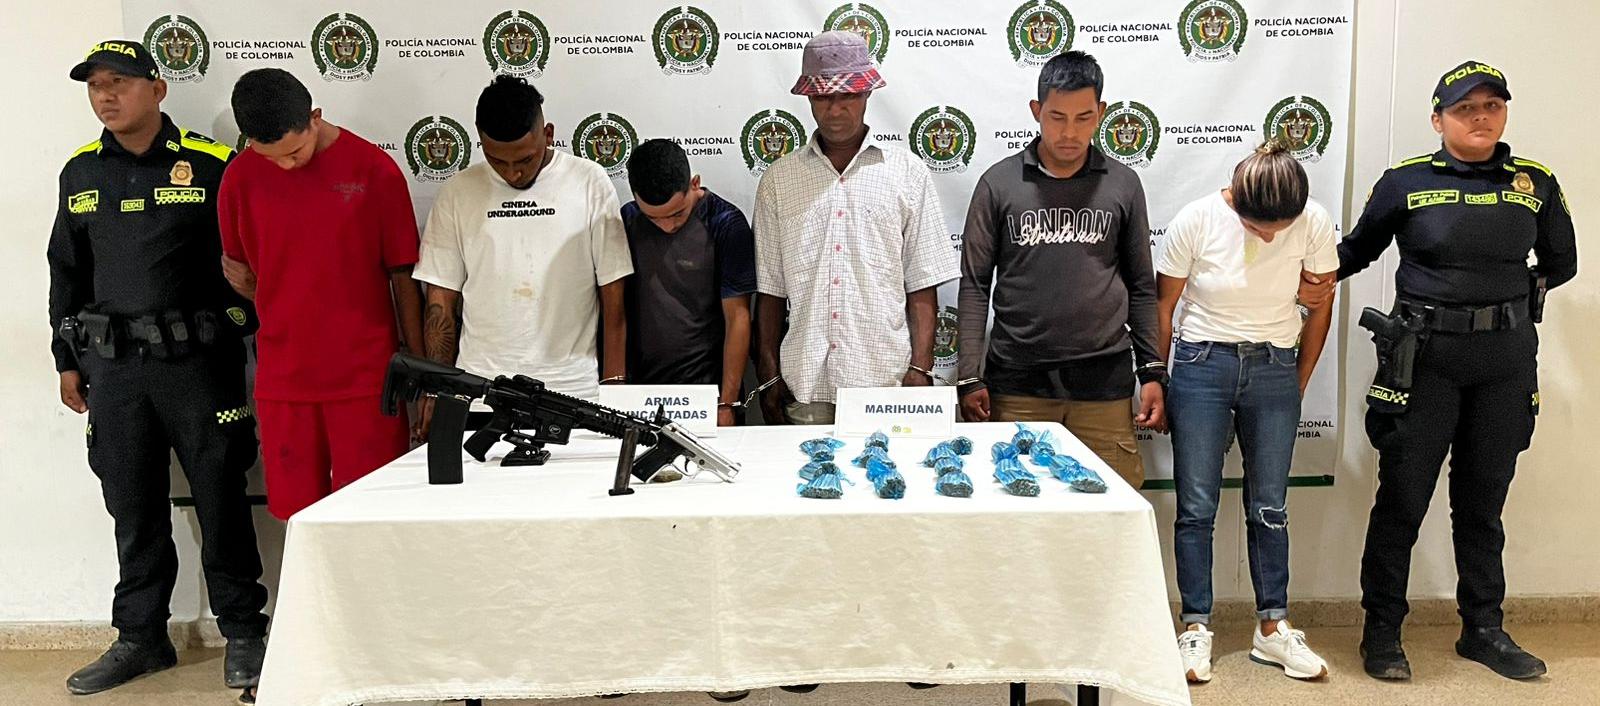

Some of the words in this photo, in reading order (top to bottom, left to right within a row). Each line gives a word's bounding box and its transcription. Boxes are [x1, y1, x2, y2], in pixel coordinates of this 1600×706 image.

[1255, 17, 1292, 26] POLICÍA
[1294, 16, 1348, 25] NACIONAL
[895, 28, 933, 37] POLICÍA
[936, 28, 987, 36] NACIONAL
[1080, 24, 1118, 33] POLICÍA
[1121, 23, 1172, 31] NACIONAL
[1281, 28, 1334, 37] COLOMBIA
[554, 34, 592, 44] POLICÍA
[595, 35, 645, 43] NACIONAL
[724, 30, 762, 40] POLICÍA
[1107, 34, 1159, 42] COLOMBIA
[213, 40, 251, 49] POLICÍA
[254, 41, 306, 49] NACIONAL
[385, 37, 423, 47] POLICÍA
[426, 38, 477, 46] NACIONAL
[752, 42, 803, 50] COLOMBIA
[923, 39, 974, 47] COLOMBIA
[582, 46, 633, 54] COLOMBIA
[995, 129, 1033, 138] POLICÍA
[1165, 124, 1202, 134] POLICÍA
[1205, 125, 1256, 133] NACIONAL
[1192, 136, 1242, 144] COLOMBIA
[687, 148, 722, 156] LOMBIA
[487, 208, 555, 218] UNDERGROUND
[1007, 208, 1112, 244] LONDON
[1020, 222, 1103, 246] Streetwear
[645, 397, 690, 406] ARMAS
[865, 404, 943, 414] MARIHUANA
[626, 411, 708, 420] NCATADAS
